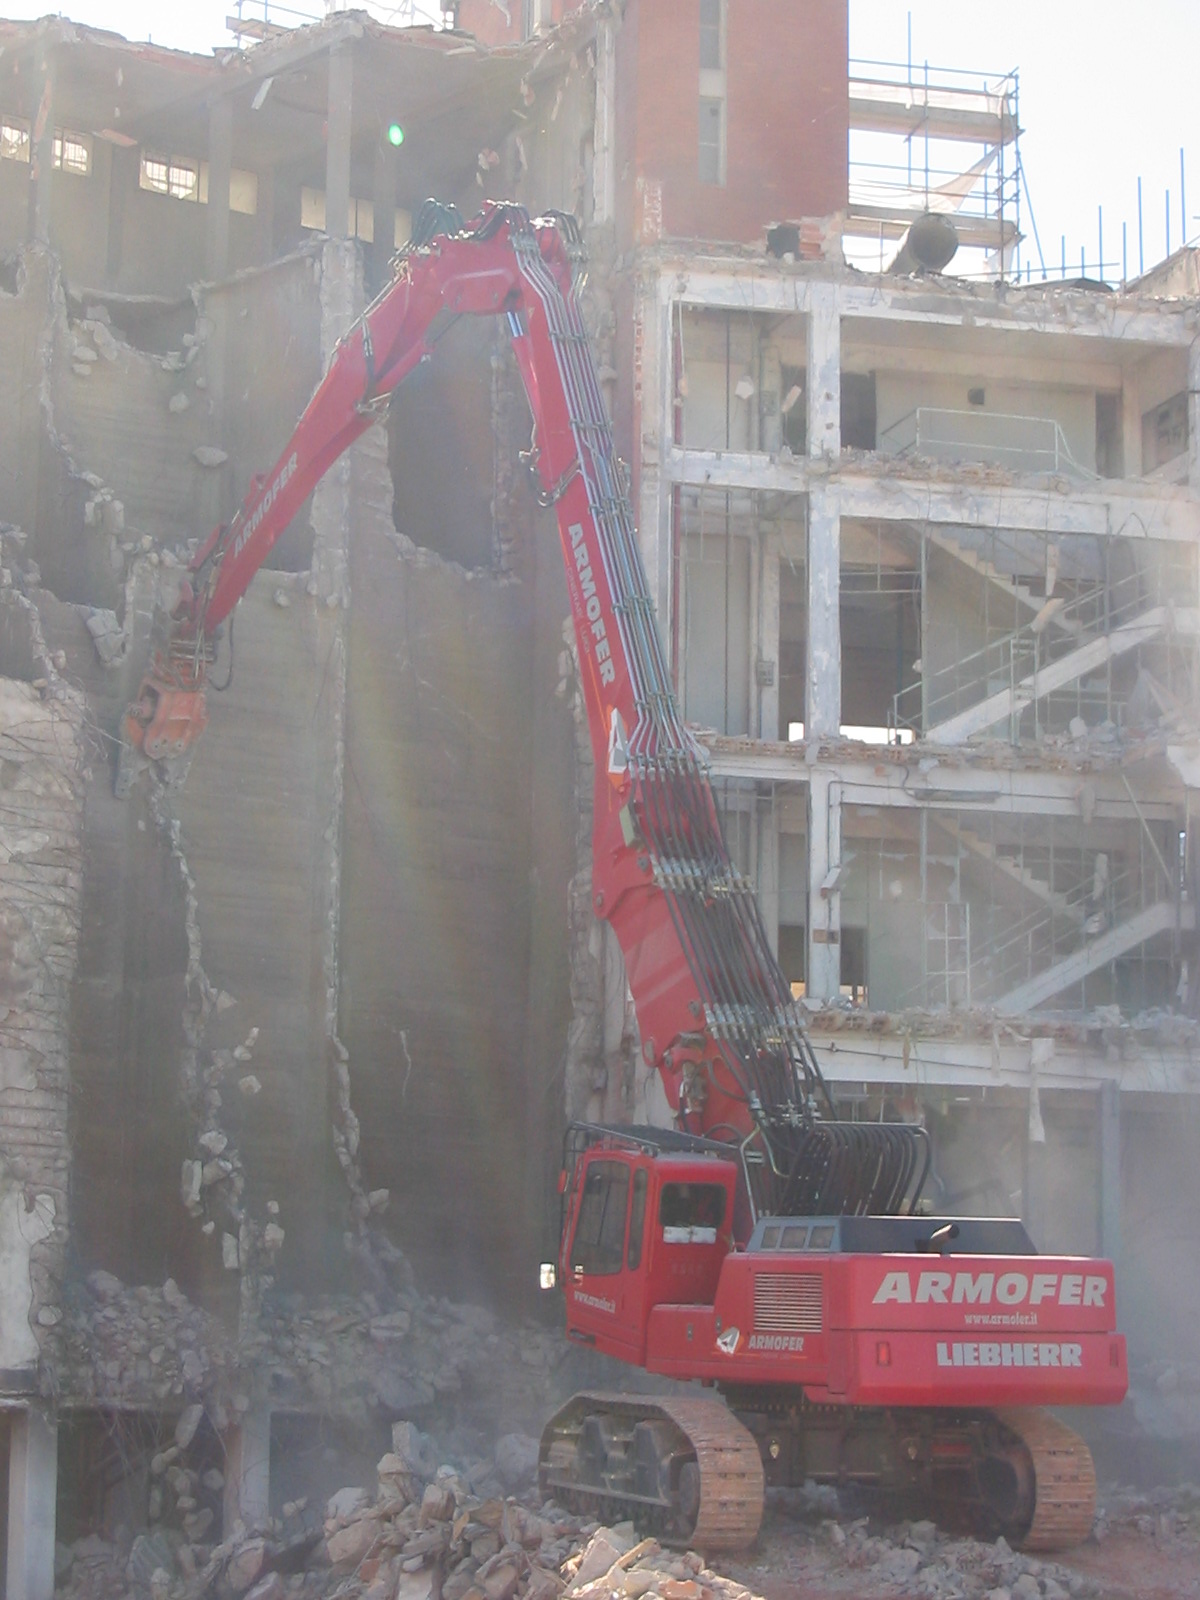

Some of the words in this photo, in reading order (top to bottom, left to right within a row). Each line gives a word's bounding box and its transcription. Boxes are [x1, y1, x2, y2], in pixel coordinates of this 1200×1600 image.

[233, 451, 298, 559] ARMOFER
[568, 522, 616, 688] ARMOFER
[872, 1271, 1108, 1307] ARMOFER
[964, 1311, 1038, 1325] www.armofer.it
[748, 1334, 805, 1352] ARMOFER
[936, 1341, 1082, 1367] LIEBHERR
